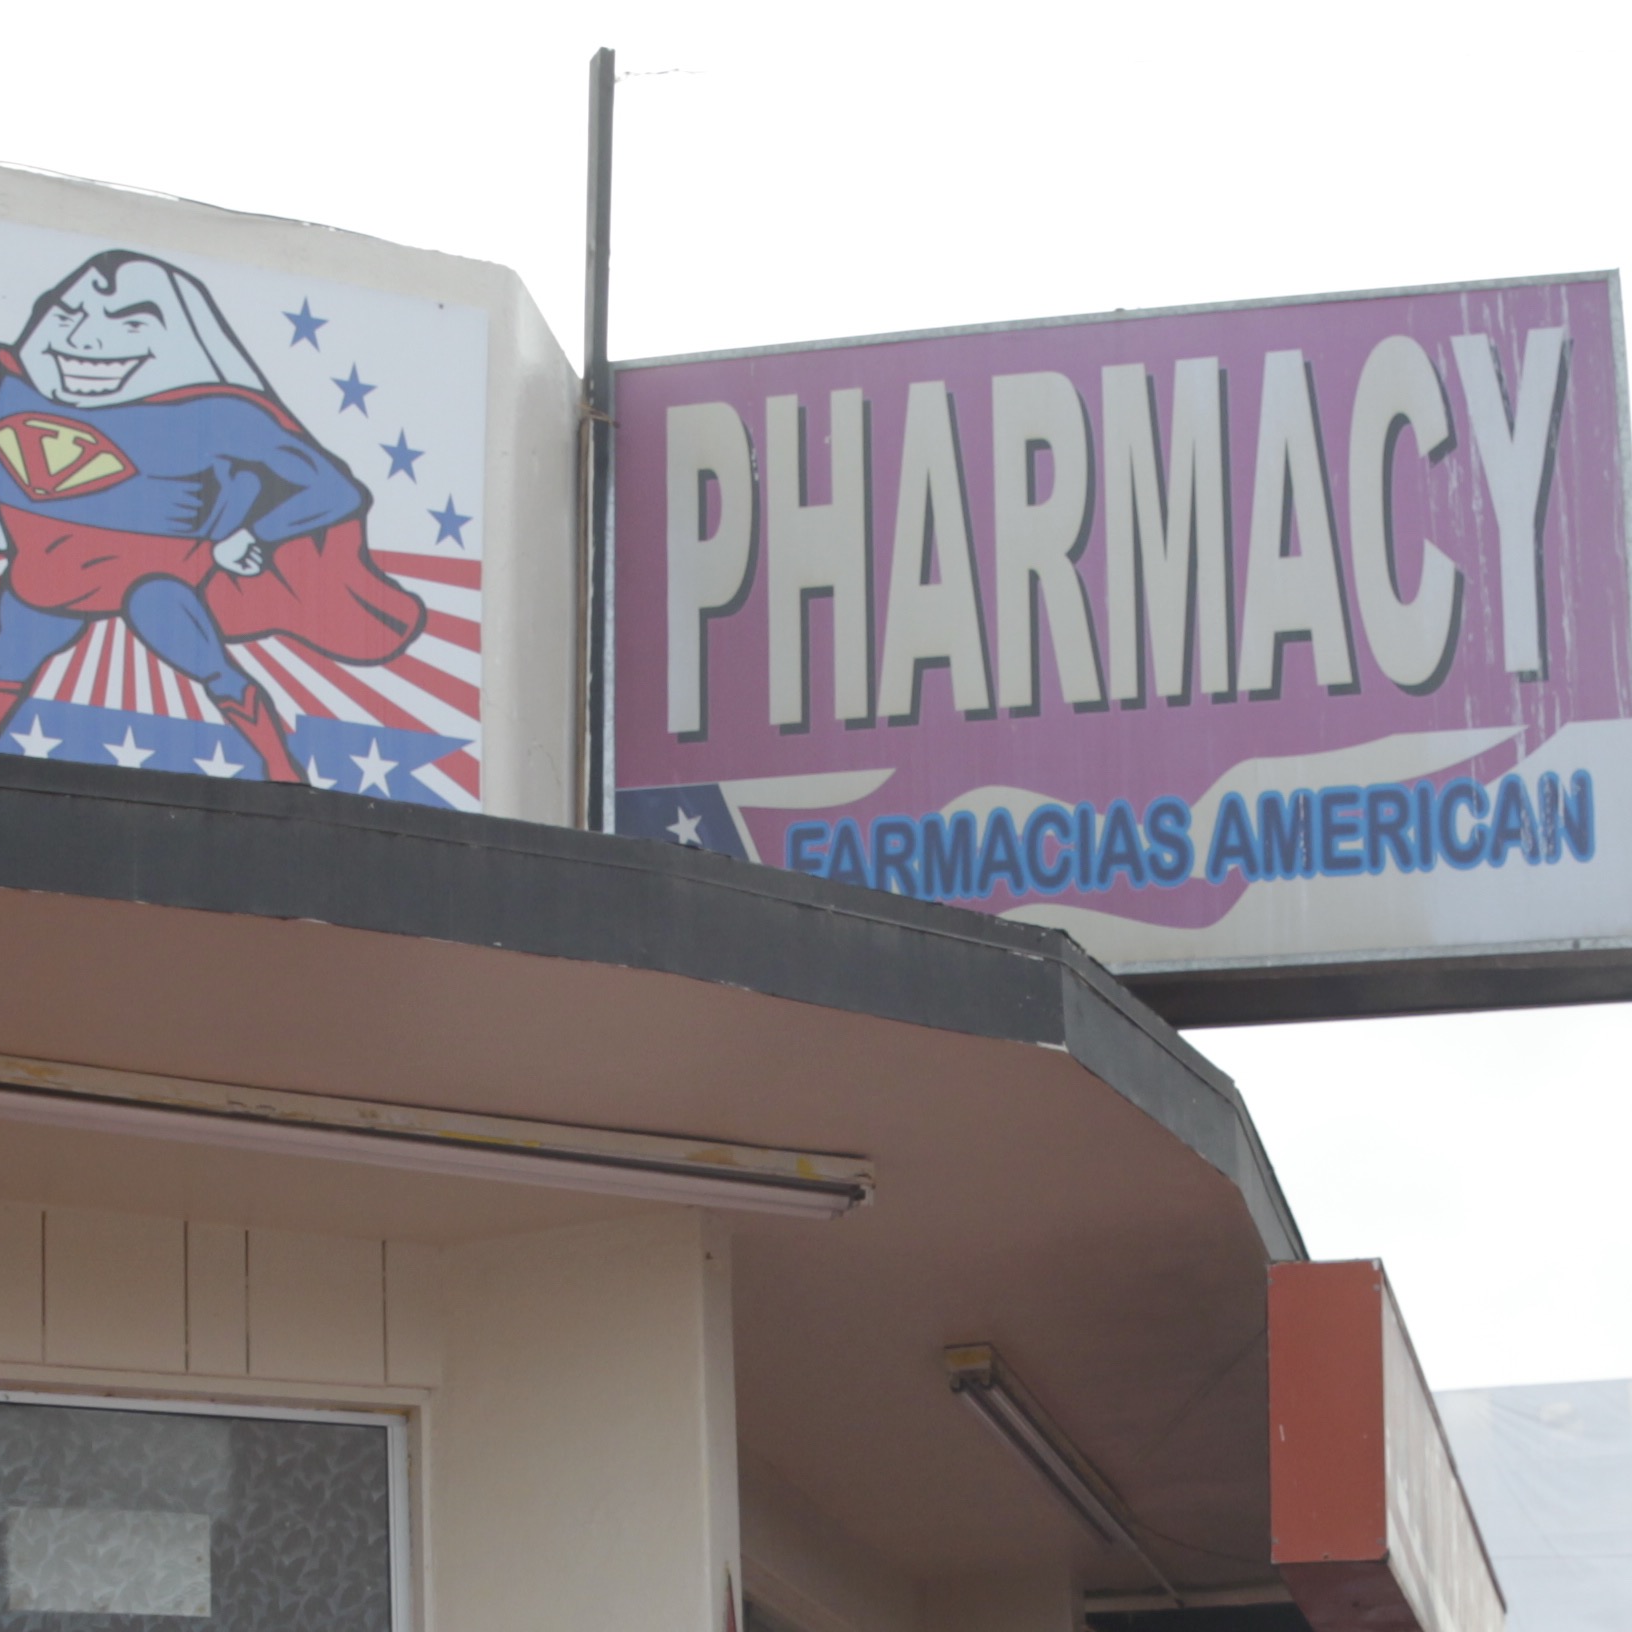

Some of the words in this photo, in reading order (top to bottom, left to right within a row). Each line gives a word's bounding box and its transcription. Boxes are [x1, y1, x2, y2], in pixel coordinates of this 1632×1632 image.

[667, 326, 1573, 743] PHARMACY
[786, 796, 1194, 901] FARMACIAS
[1206, 768, 1595, 887] AMERICAN
